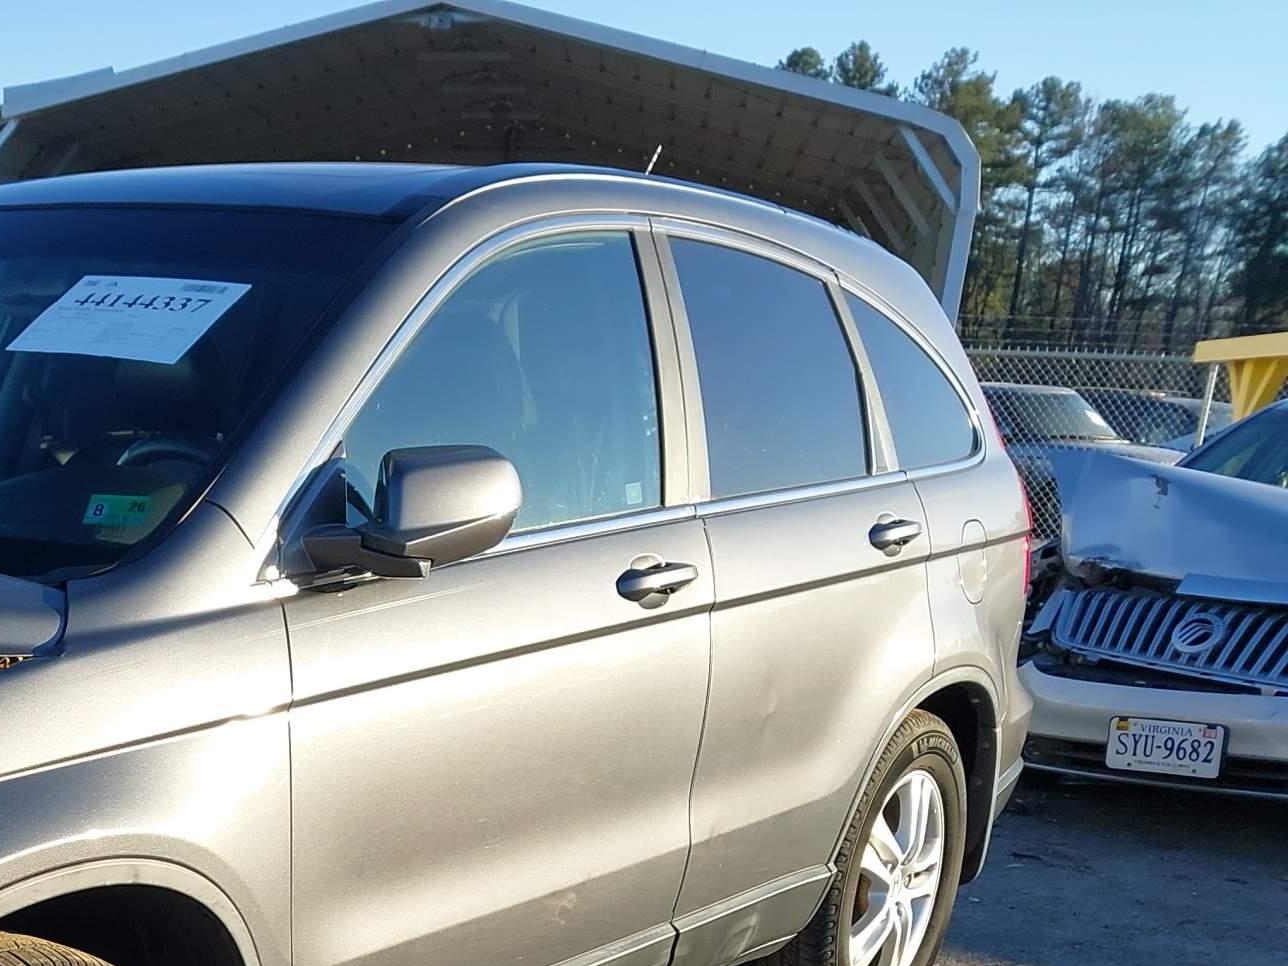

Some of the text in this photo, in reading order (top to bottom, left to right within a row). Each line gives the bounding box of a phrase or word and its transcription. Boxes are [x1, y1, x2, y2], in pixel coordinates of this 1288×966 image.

[74, 292, 212, 313] 44144337
[92, 503, 105, 516] 8
[1140, 723, 1193, 737] VIRGINIA
[1115, 733, 1215, 764] SYU-9682
